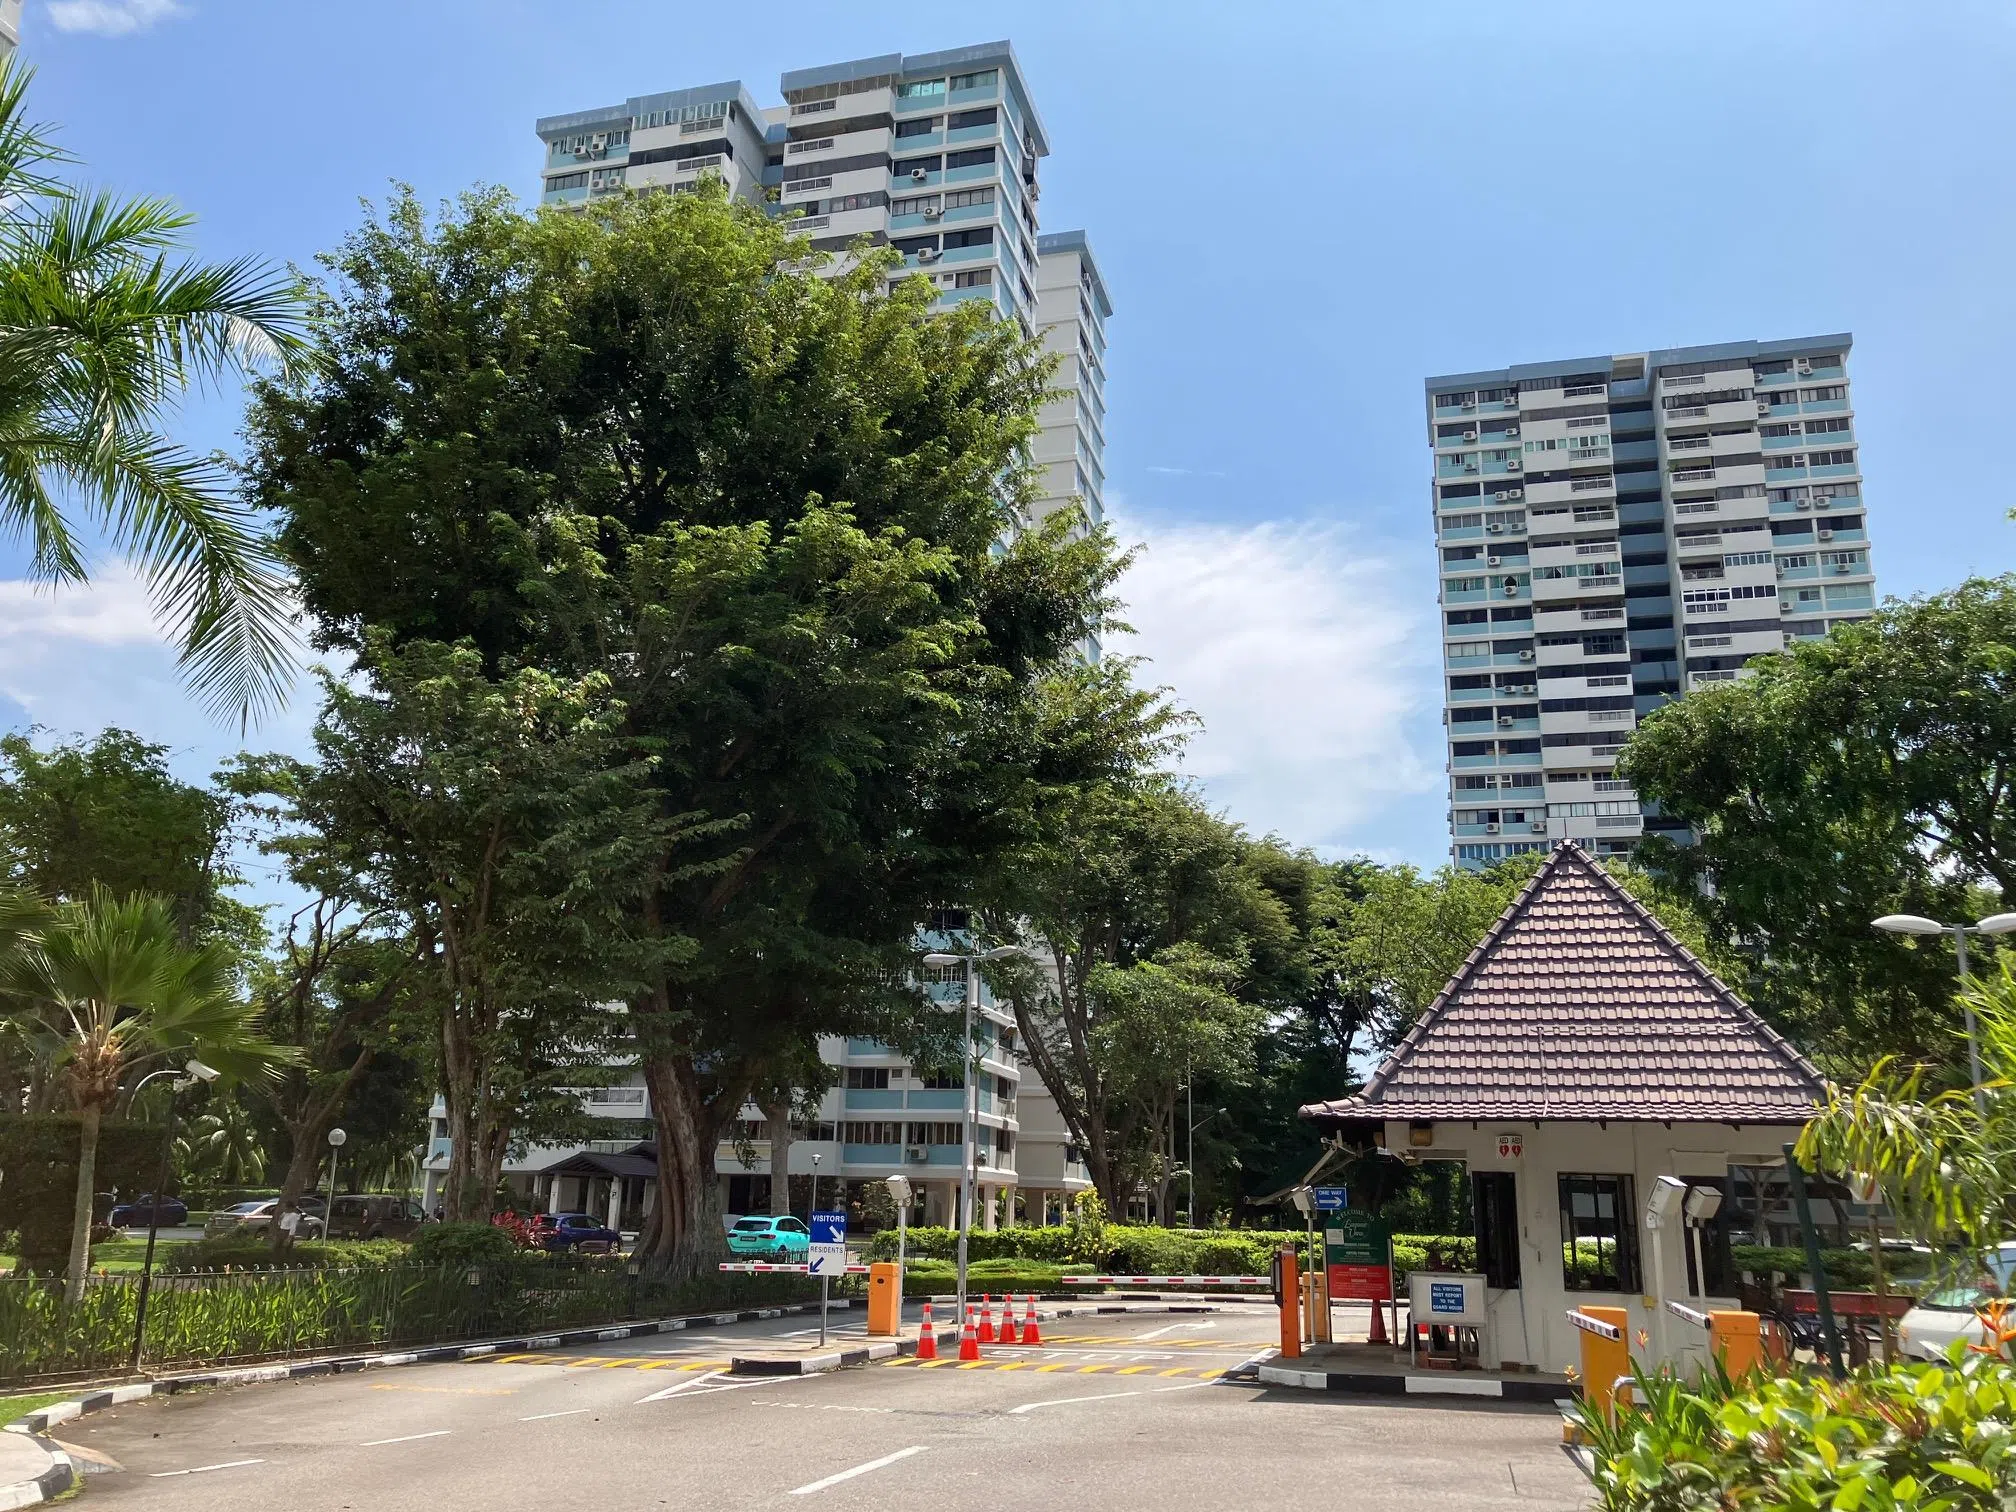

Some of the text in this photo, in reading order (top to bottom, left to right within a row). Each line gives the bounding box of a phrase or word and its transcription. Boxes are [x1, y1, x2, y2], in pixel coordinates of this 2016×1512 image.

[812, 1214, 845, 1223] VISITORS
[1336, 1209, 1375, 1221] WELCOME TO
[810, 1246, 843, 1254] RESIDENTS
[982, 1350, 1174, 1362] STOP
